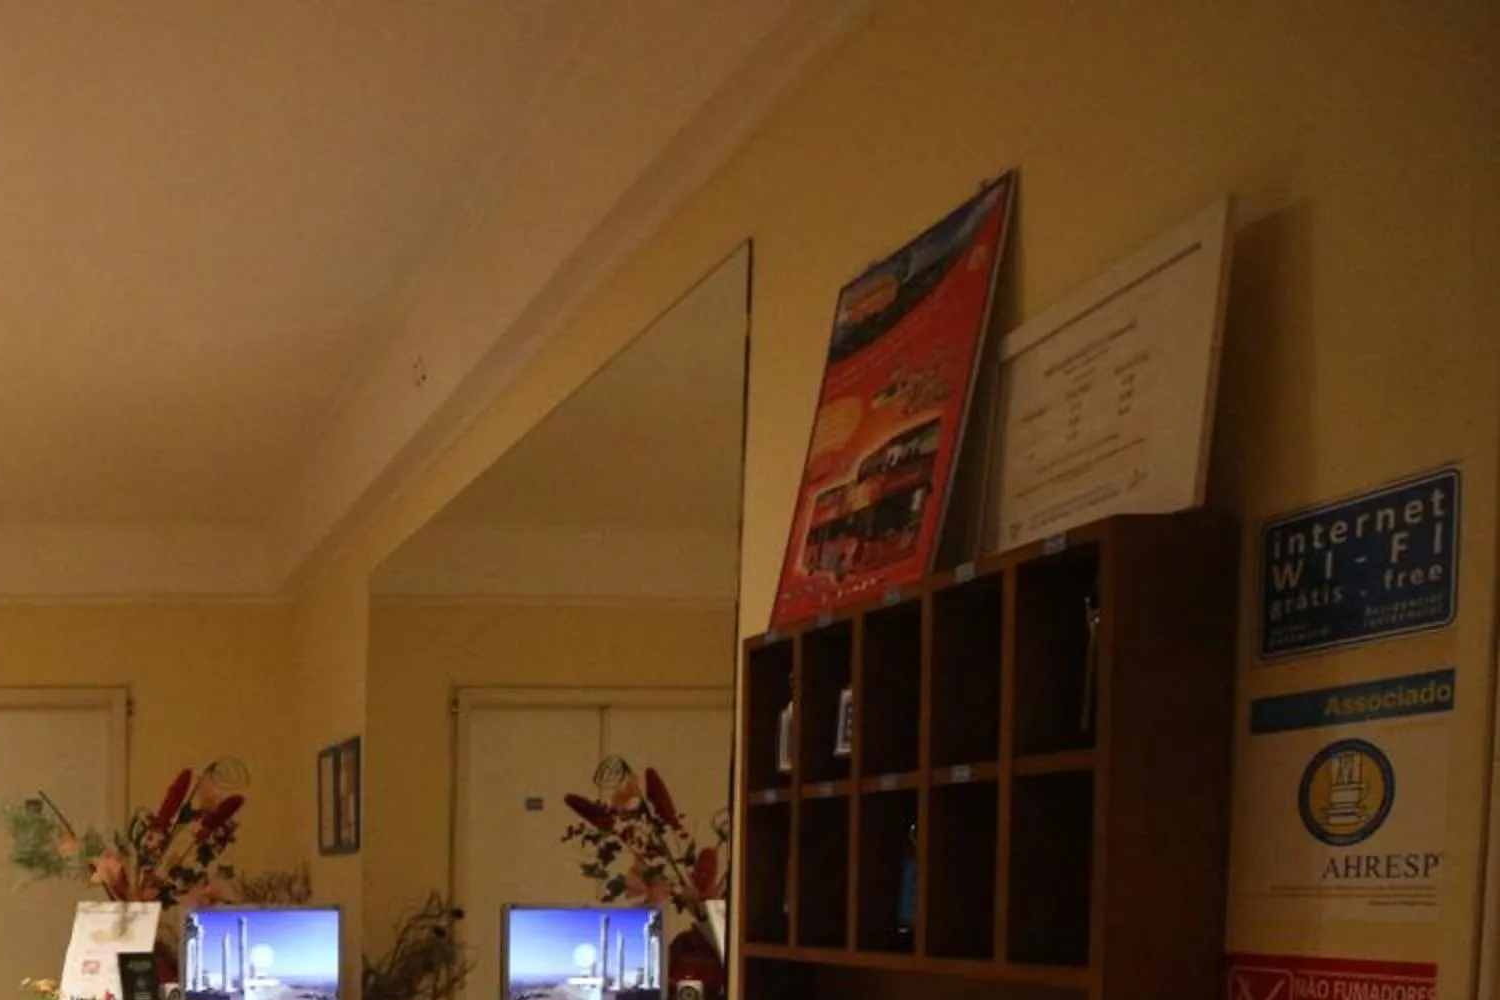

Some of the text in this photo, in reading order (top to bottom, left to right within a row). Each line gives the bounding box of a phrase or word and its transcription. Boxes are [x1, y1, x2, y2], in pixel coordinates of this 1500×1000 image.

[1273, 488, 1445, 559] internet
[1384, 563, 1444, 592] free
[1324, 680, 1452, 717] Associado
[1322, 852, 1441, 881] AHRESP
